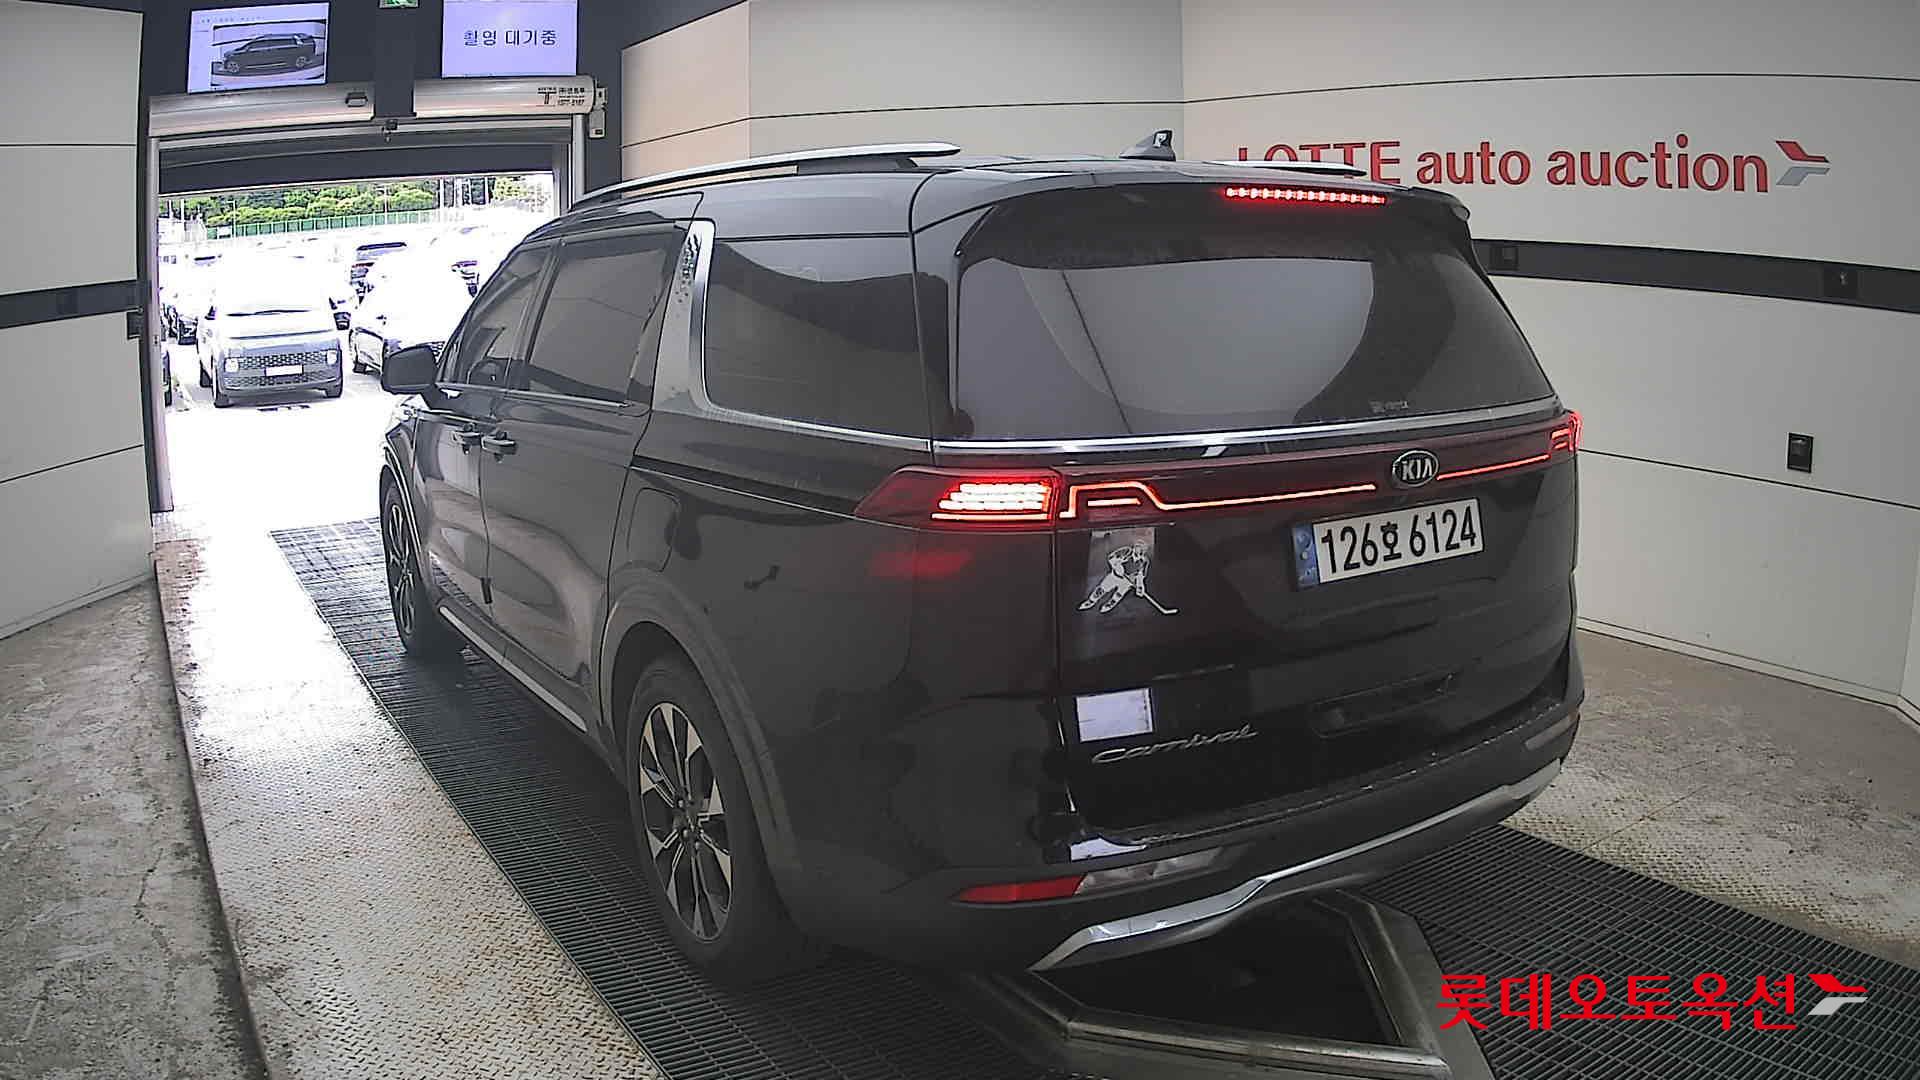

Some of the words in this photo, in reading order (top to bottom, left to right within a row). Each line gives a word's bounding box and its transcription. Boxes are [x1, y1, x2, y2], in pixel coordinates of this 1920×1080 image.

[505, 30, 557, 46] 대기중
[1416, 142, 1531, 186] auto
[1546, 134, 1769, 193] auction
[1401, 458, 1433, 481] KIA
[1321, 521, 1403, 574] 126호
[1409, 506, 1477, 557] 6124
[1091, 723, 1258, 764] Carnival
